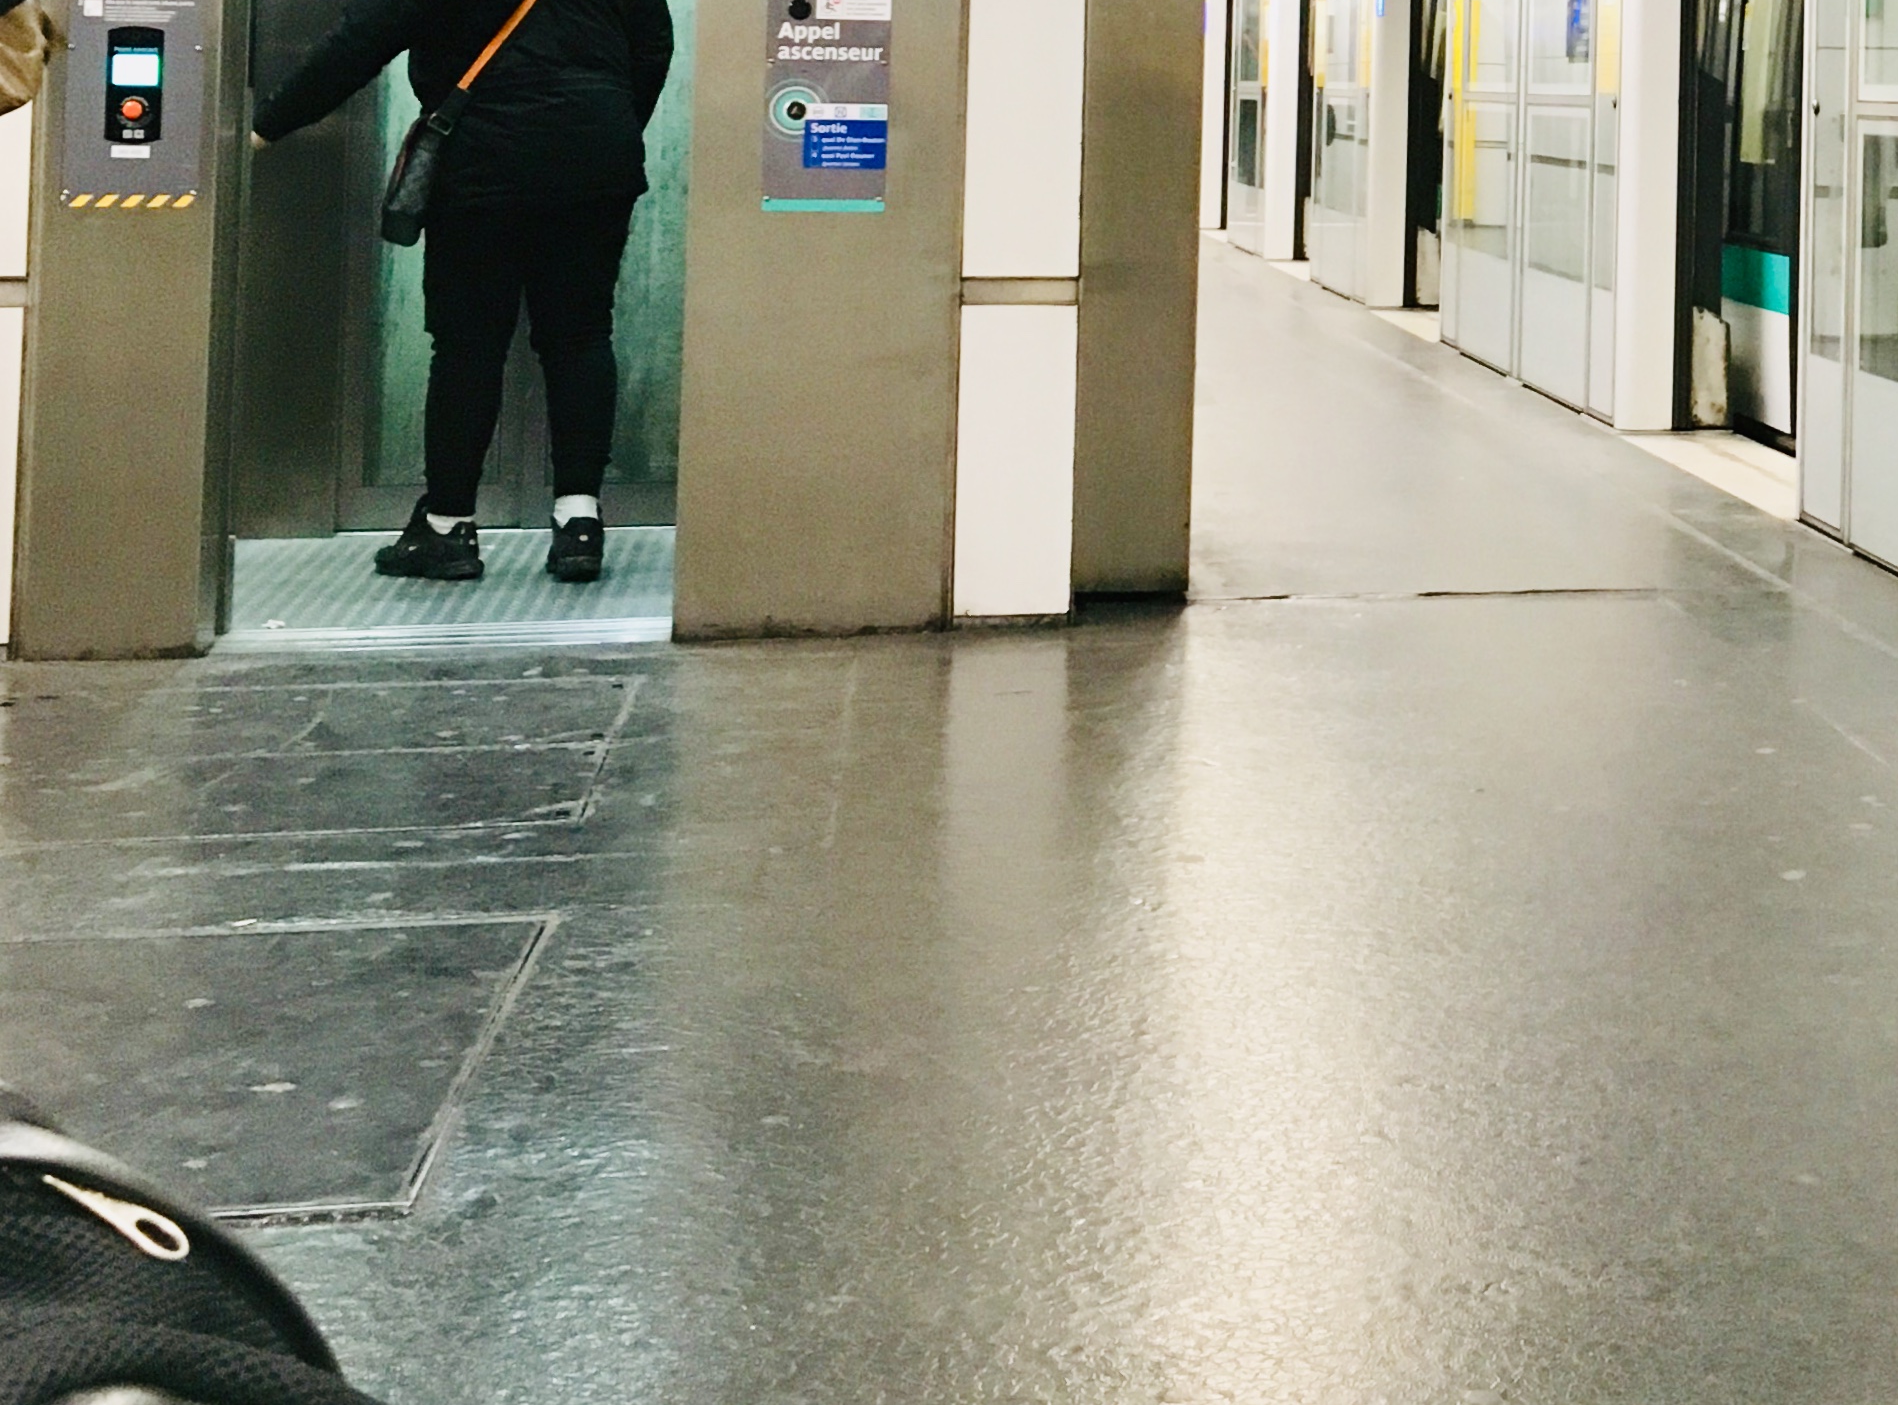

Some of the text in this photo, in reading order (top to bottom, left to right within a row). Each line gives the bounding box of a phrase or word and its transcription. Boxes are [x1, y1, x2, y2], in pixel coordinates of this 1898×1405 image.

[777, 21, 841, 44] Appel
[777, 45, 884, 62] ascenseur
[810, 122, 848, 134] Sortie
